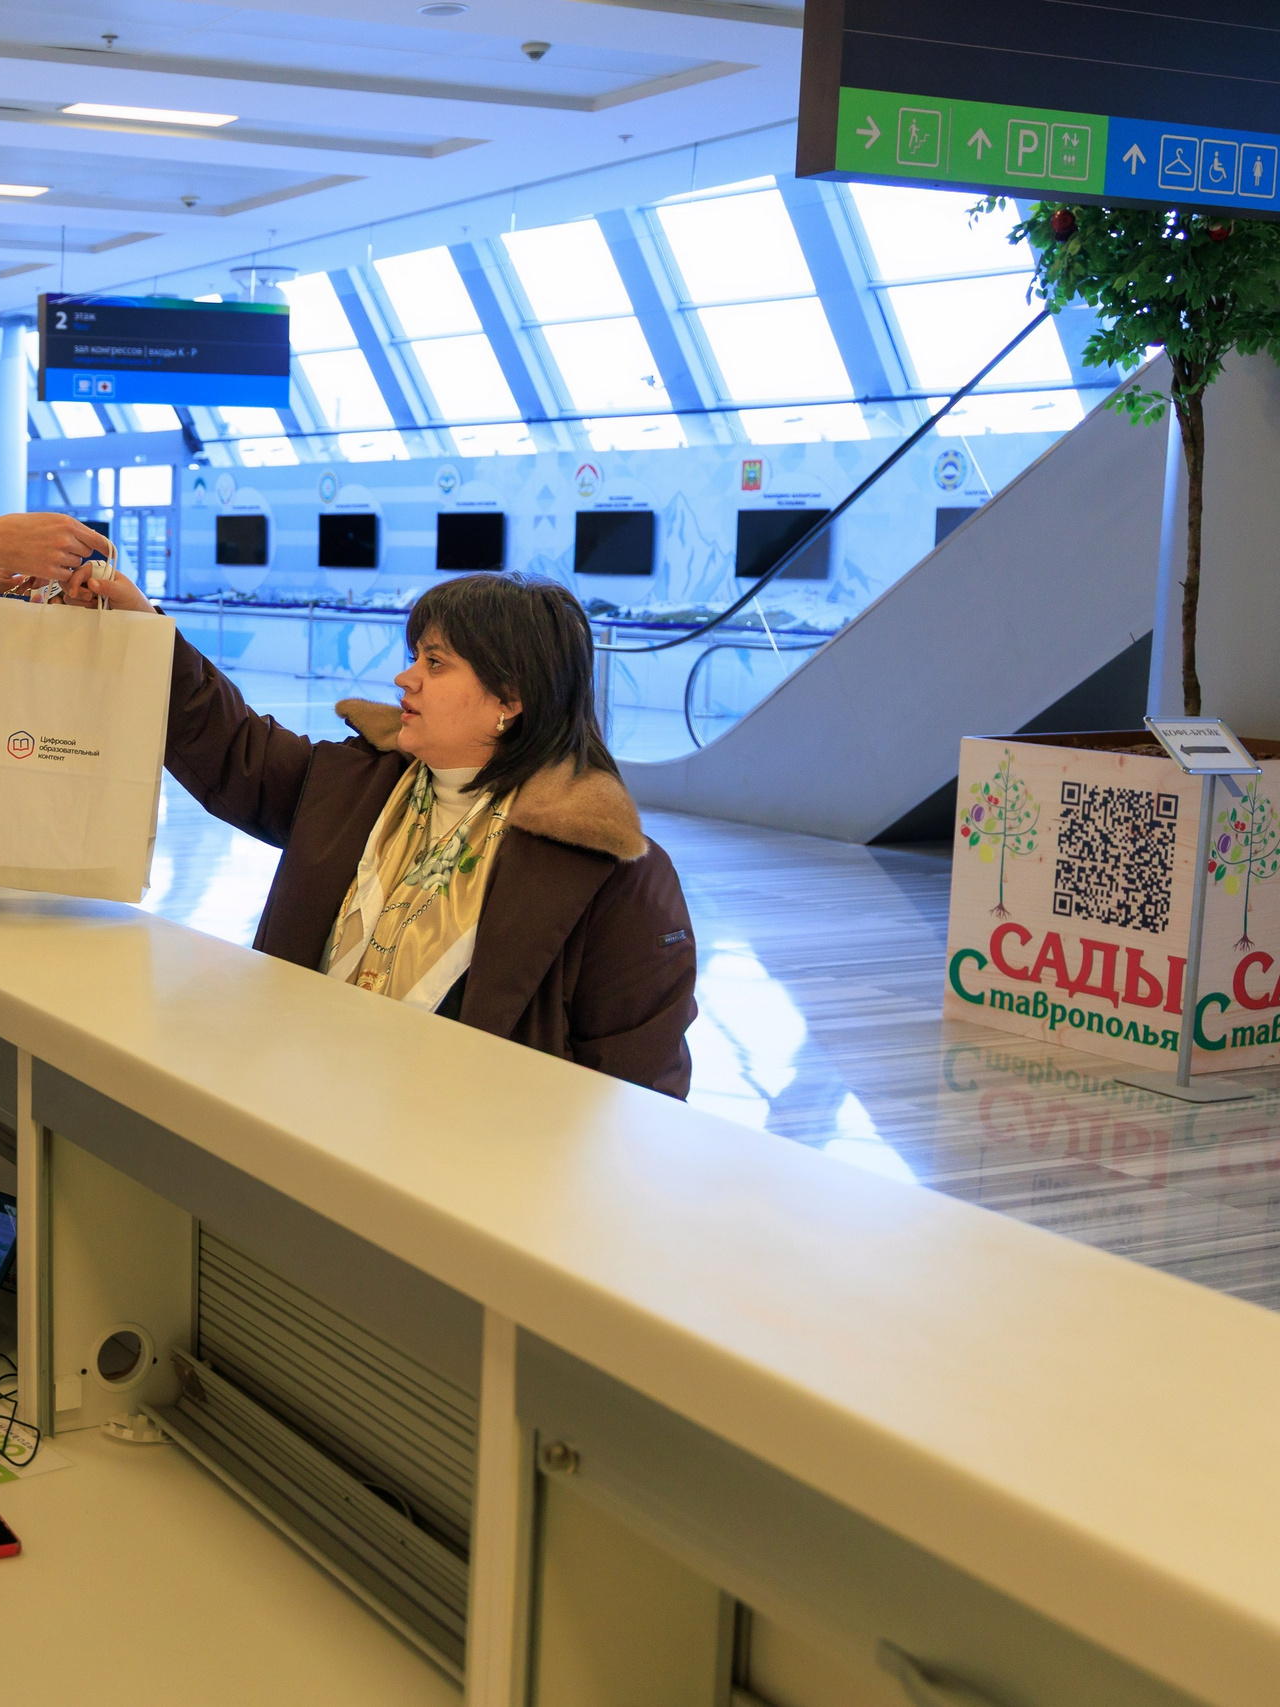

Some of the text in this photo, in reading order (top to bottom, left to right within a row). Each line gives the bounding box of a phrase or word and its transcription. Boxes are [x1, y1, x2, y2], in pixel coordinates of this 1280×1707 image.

[55, 311, 68, 330] 2
[73, 312, 97, 321] этаж
[73, 345, 89, 353] зал
[91, 345, 143, 357] конгрессов
[148, 347, 176, 358] входы
[1161, 728, 1221, 737] КОФЕ-БРЕЙК
[40, 736, 77, 747] Цифровой
[38, 752, 66, 761] контент
[39, 745, 100, 757] образовательный
[989, 922, 1187, 1015] САДЫ
[949, 948, 1180, 1053] Ставрополья
